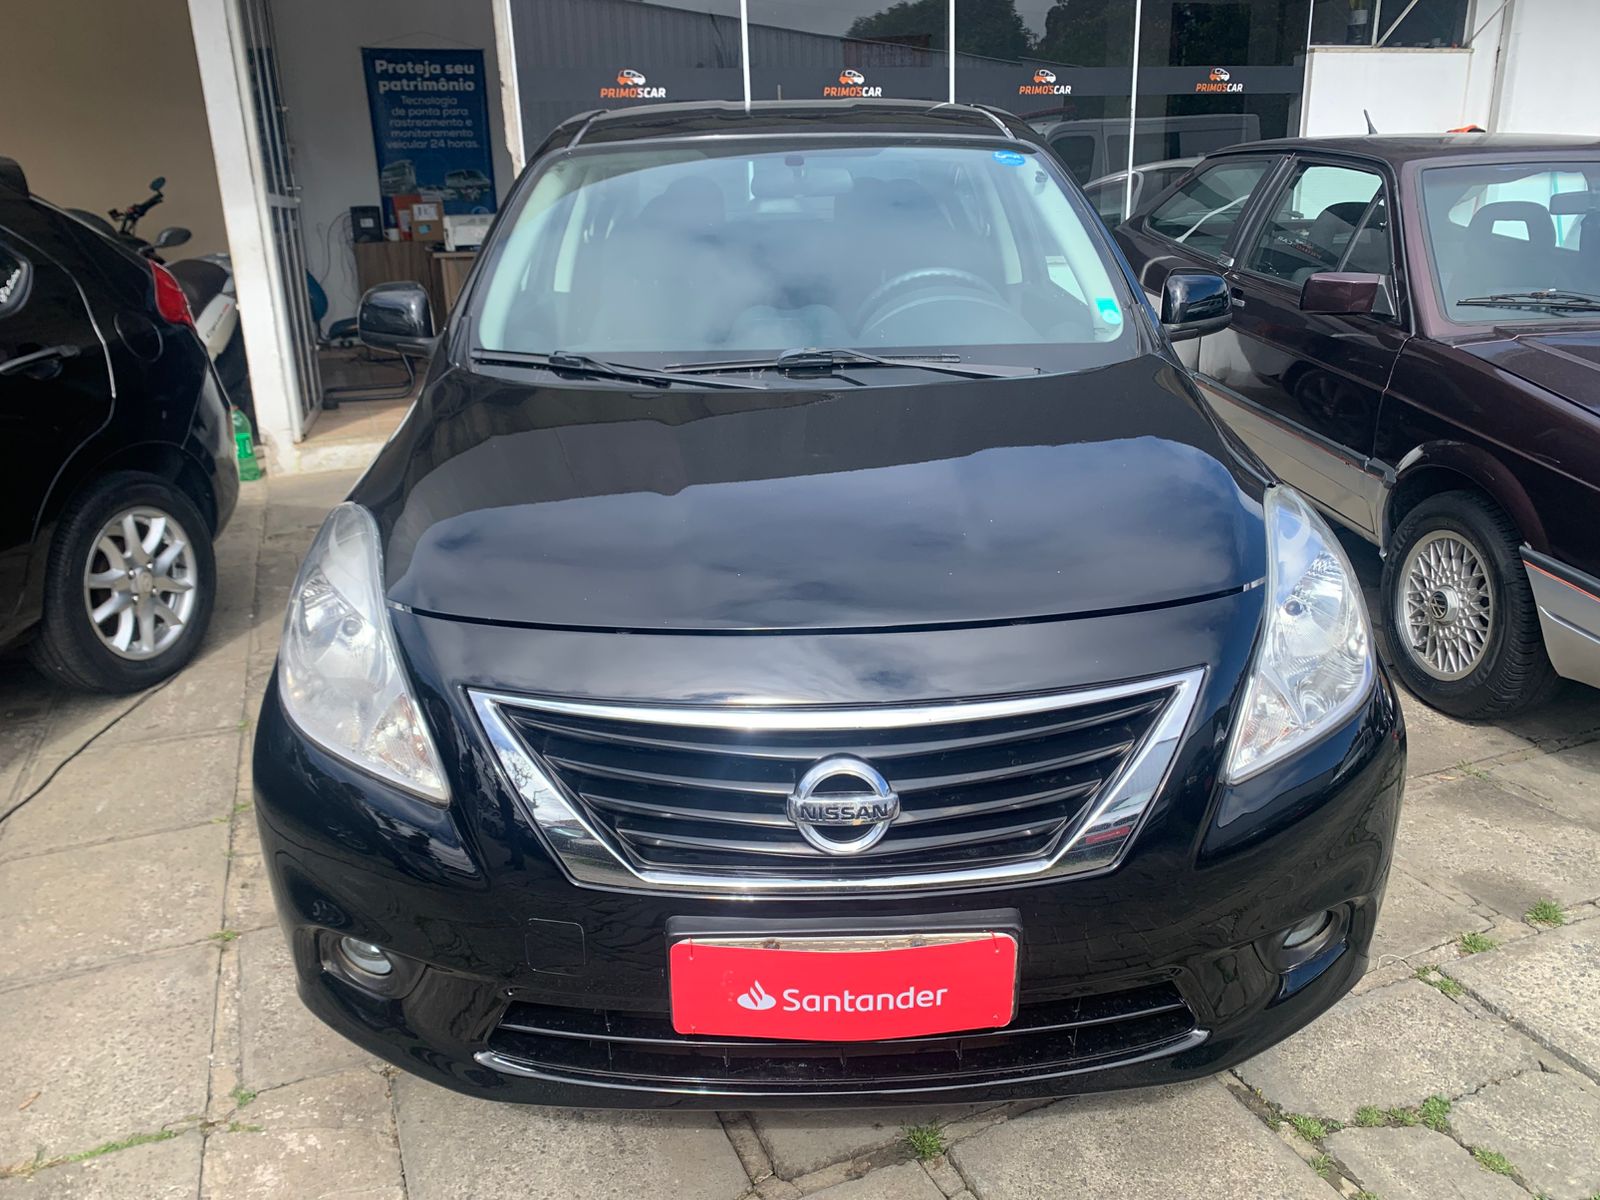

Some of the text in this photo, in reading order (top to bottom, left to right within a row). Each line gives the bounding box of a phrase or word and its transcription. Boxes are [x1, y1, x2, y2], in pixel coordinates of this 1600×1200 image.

[375, 60, 475, 77] Proteja seu
[378, 78, 475, 93] patrimônio
[401, 96, 458, 107] Tecnologia
[408, 108, 440, 118] ponta
[442, 109, 468, 118] para
[389, 118, 463, 126] rastreamento
[391, 130, 473, 138] monitoramento
[386, 140, 427, 148] veicular
[430, 139, 445, 148] 24
[800, 803, 888, 820] NISSAN
[782, 986, 949, 1013] Santander
